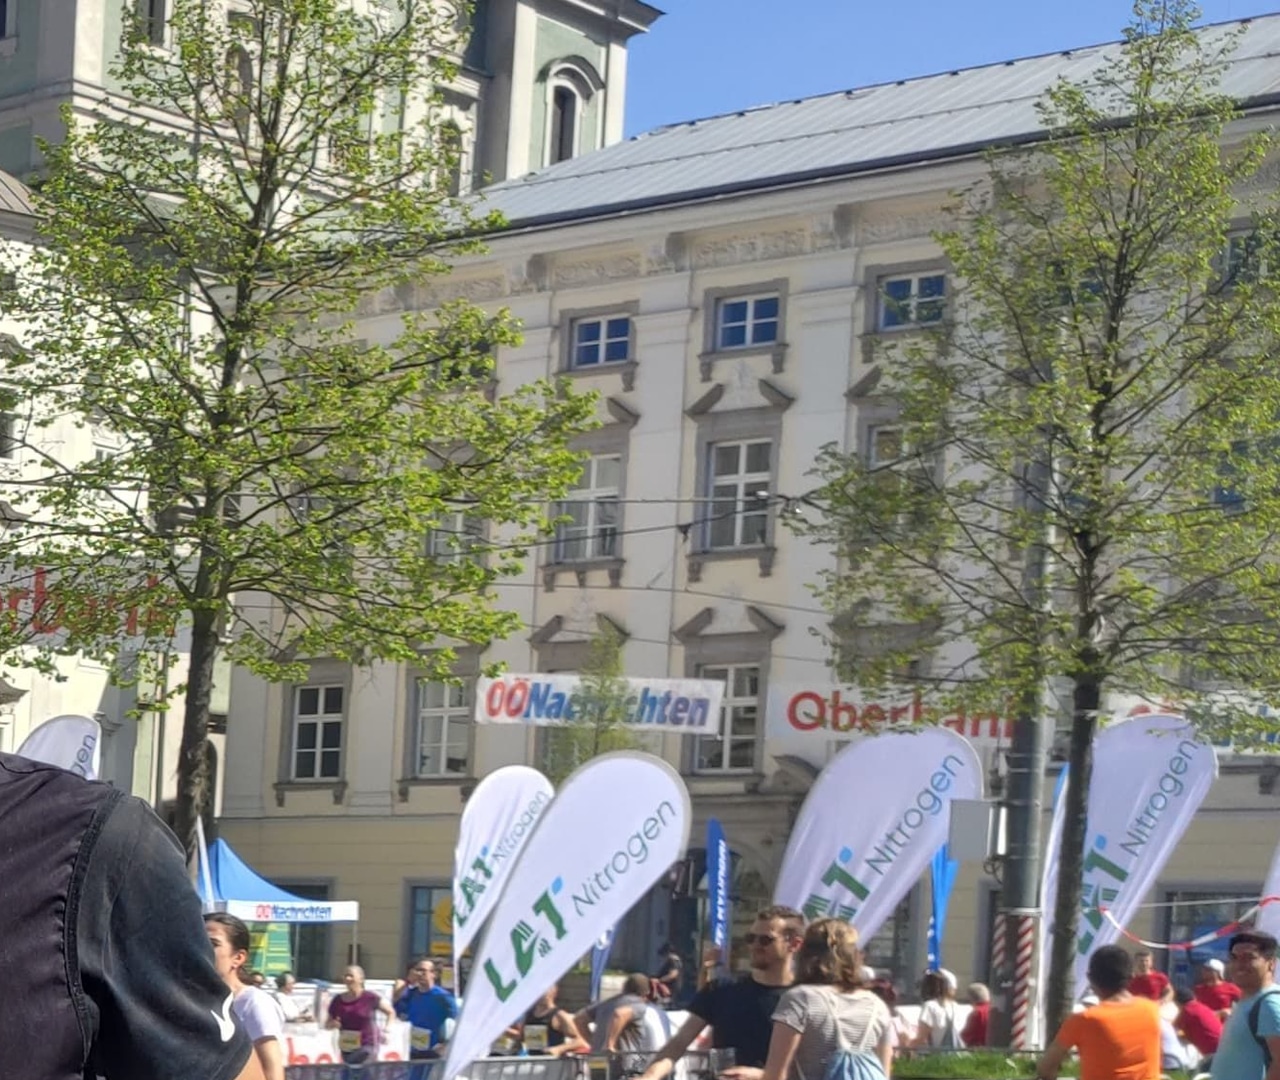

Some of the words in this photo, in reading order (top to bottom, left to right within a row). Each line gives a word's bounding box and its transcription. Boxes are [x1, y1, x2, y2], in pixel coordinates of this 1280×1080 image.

[865, 753, 964, 876] Nitrogen
[1119, 738, 1198, 857] Nitrogen
[572, 799, 678, 917] Nitrogen
